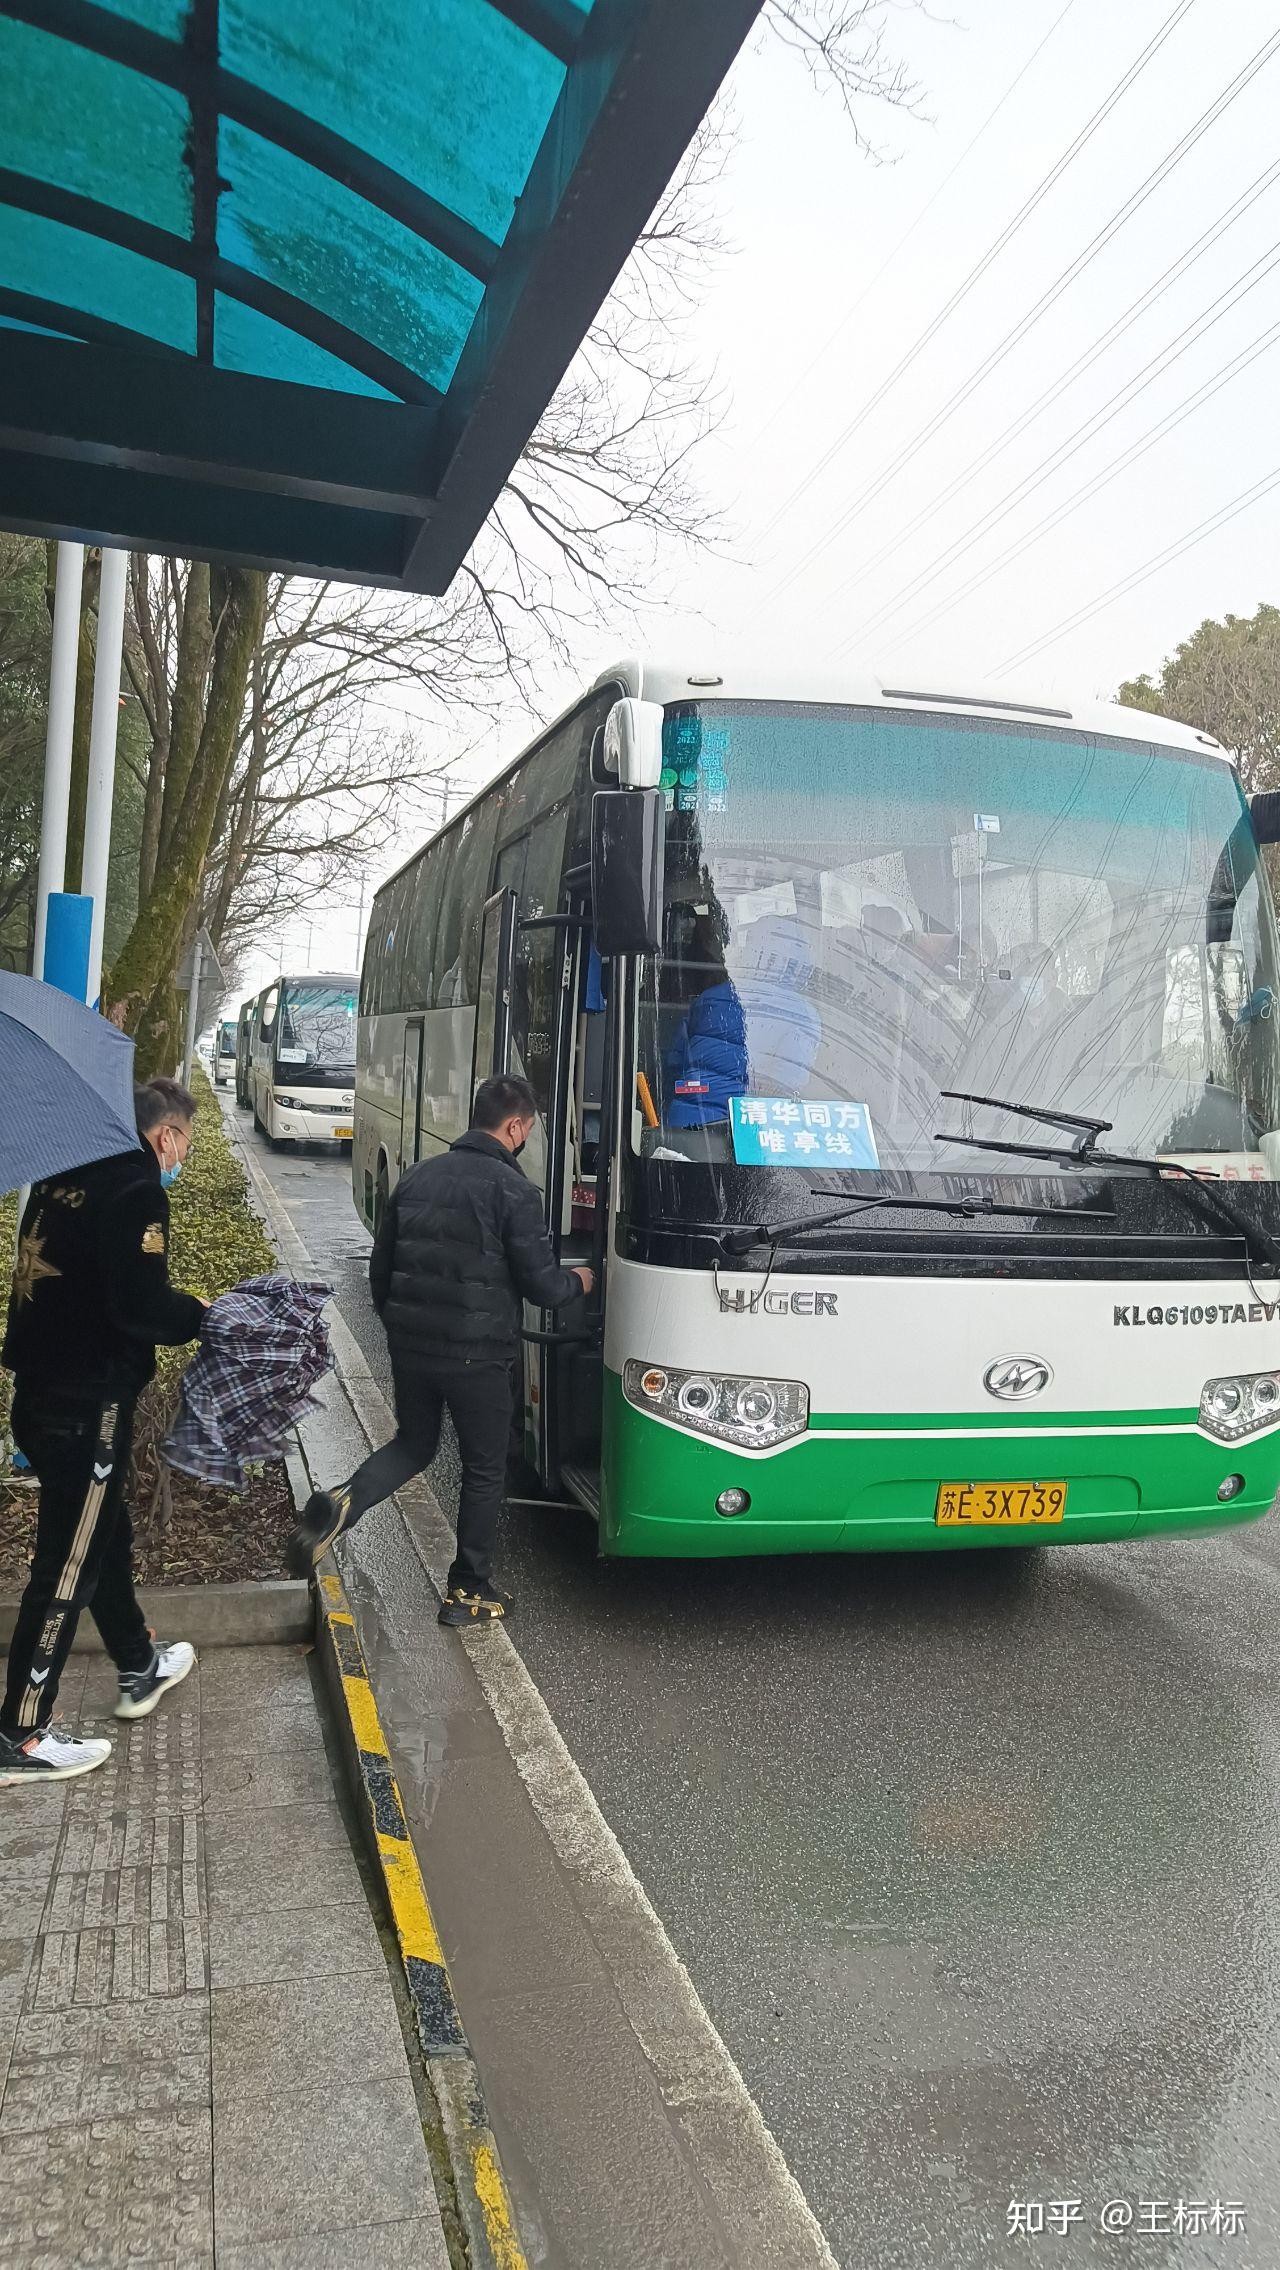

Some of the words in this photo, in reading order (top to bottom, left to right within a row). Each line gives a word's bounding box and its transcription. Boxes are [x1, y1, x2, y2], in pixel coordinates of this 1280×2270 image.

[740, 1099, 861, 1129] 清华同方
[759, 1128, 853, 1155] 唯亭线
[720, 1288, 839, 1316] HIGER
